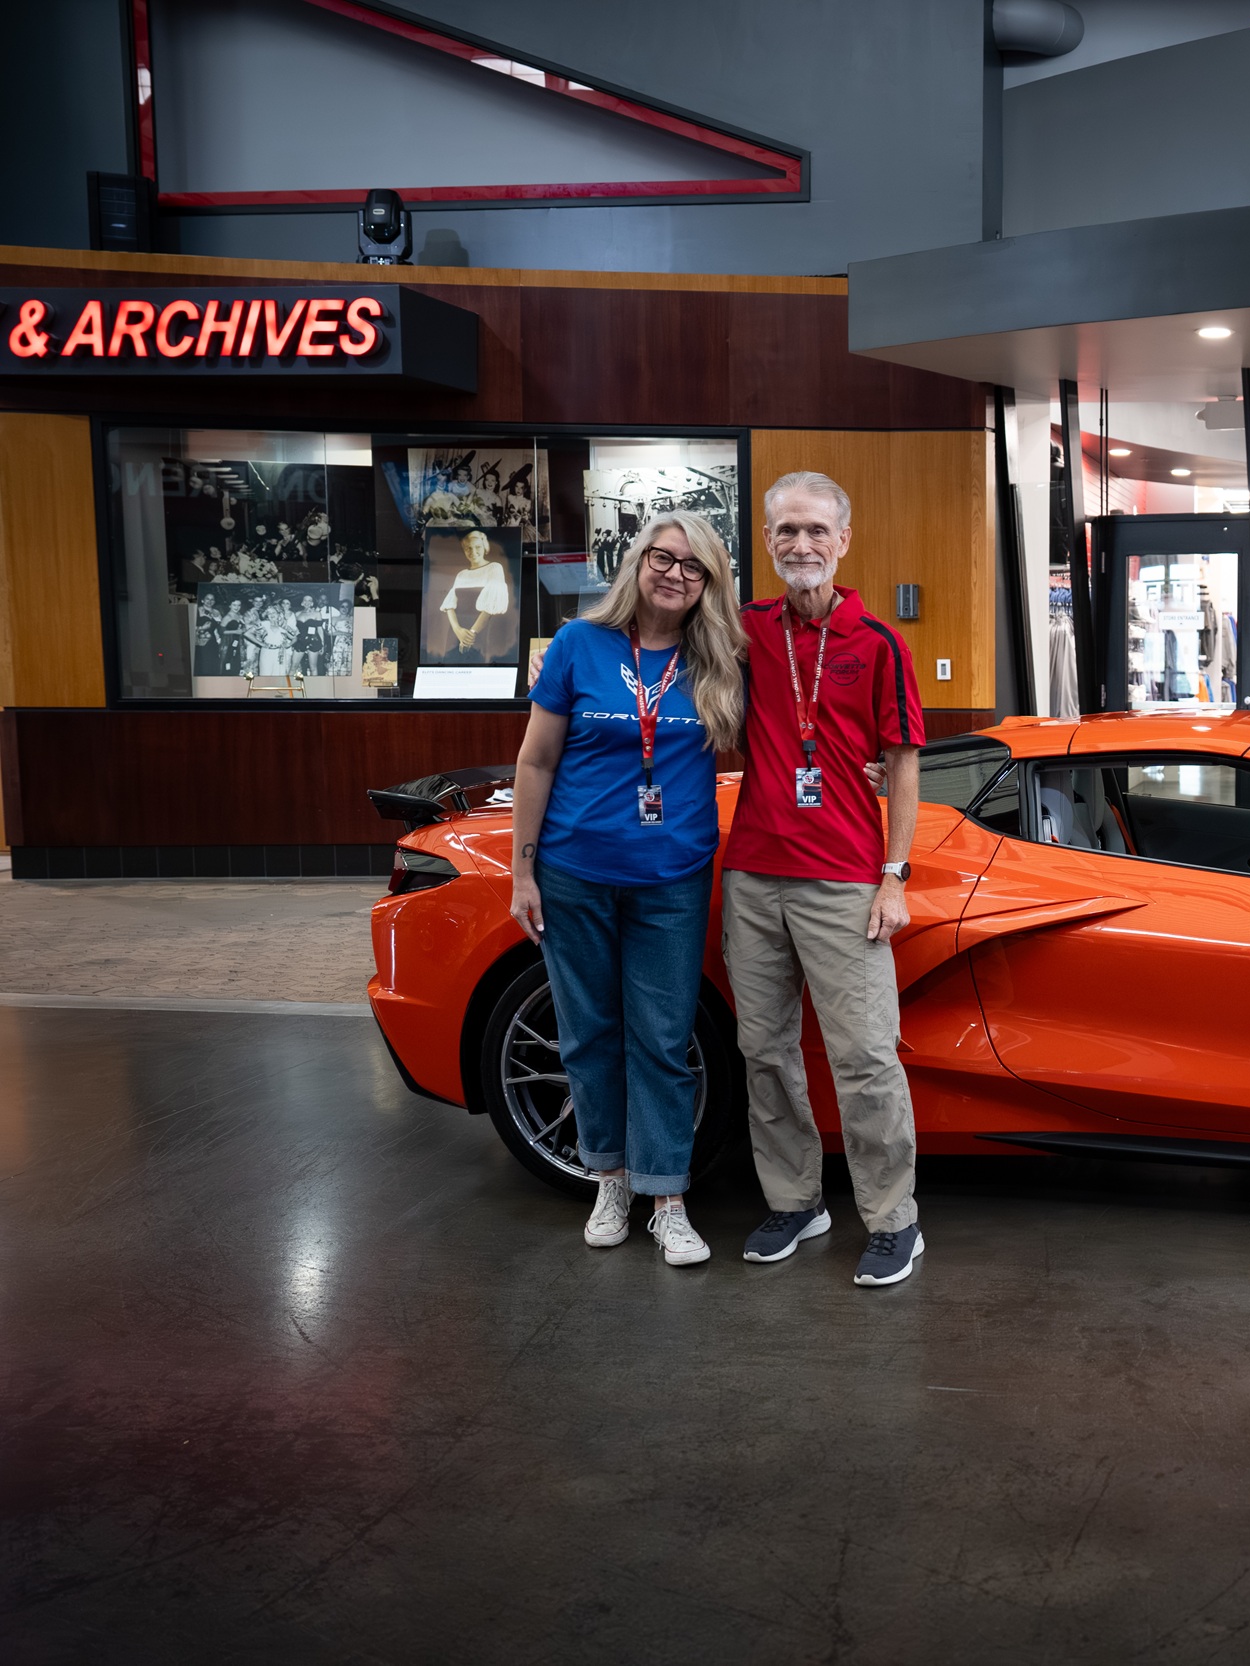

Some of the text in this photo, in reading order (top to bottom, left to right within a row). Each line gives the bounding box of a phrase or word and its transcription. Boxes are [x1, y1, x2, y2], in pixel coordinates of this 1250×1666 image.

[8, 296, 384, 359] & ARCHIVES
[787, 652, 797, 677] CORVETTE
[812, 627, 827, 703] NATIONAL CORVETTE MUSEUM
[792, 677, 801, 703] NATIONAL
[802, 795, 817, 803] VIP
[644, 813, 658, 821] VIP
